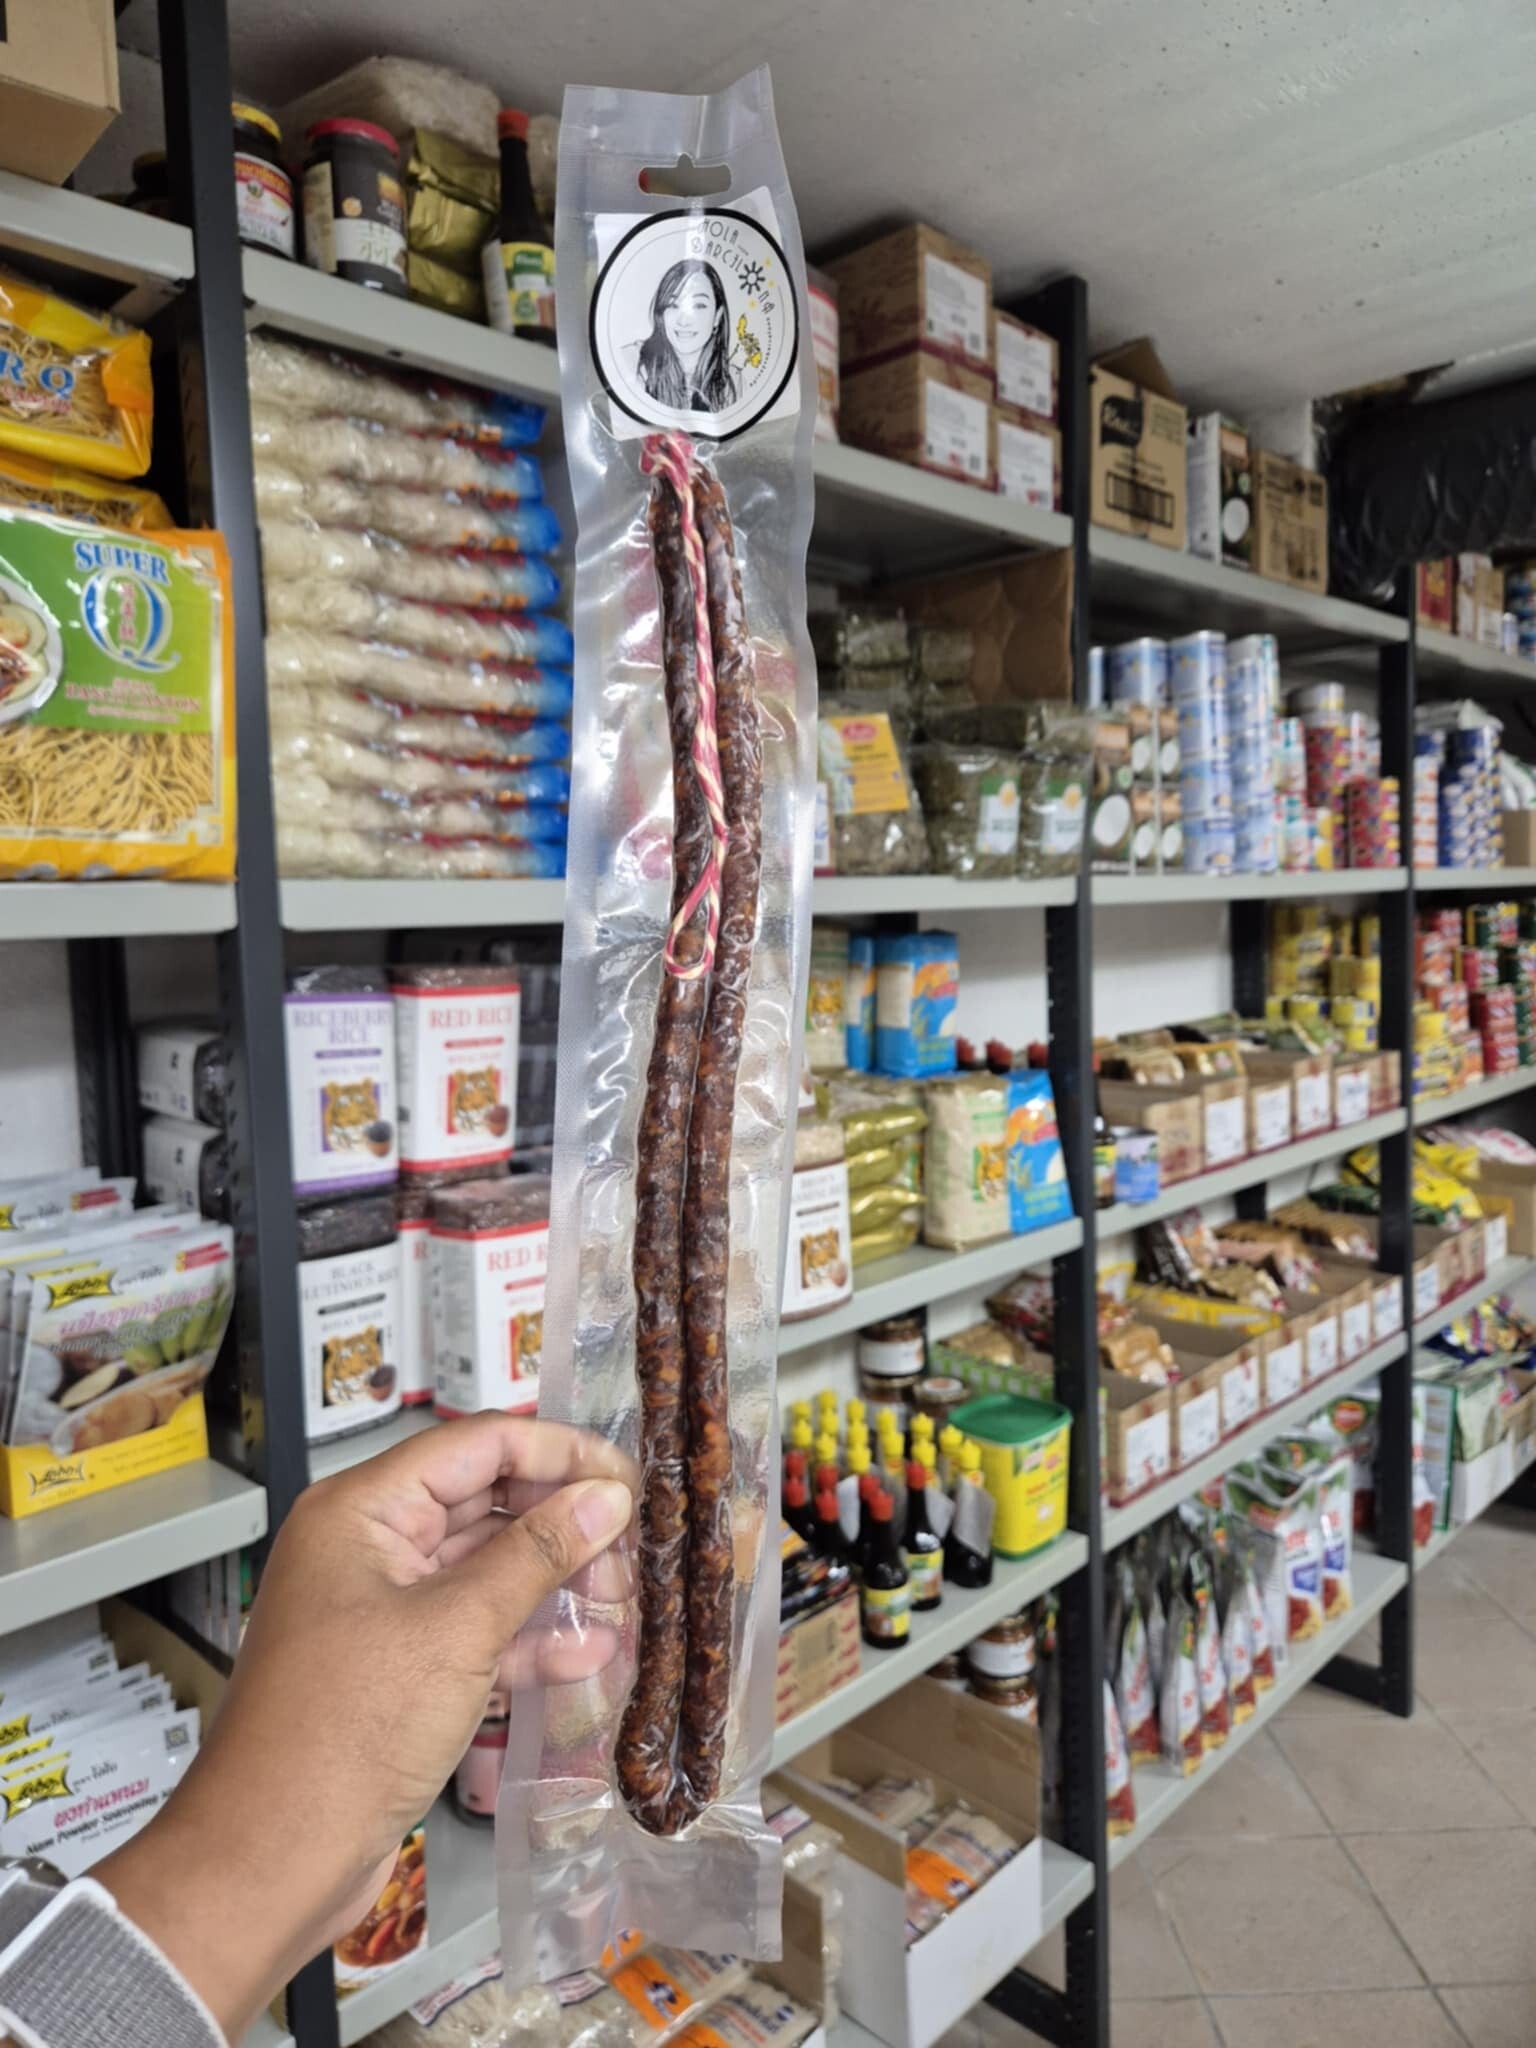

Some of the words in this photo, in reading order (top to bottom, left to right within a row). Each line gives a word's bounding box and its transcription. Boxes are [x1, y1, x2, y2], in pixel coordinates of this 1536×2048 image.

[74, 539, 172, 587] SUPER
[81, 568, 182, 673] Q
[429, 1008, 472, 1029] RED
[486, 1247, 531, 1272] RED
[56, 1815, 100, 1844] Powder
[101, 1793, 160, 1824] Seasoning
